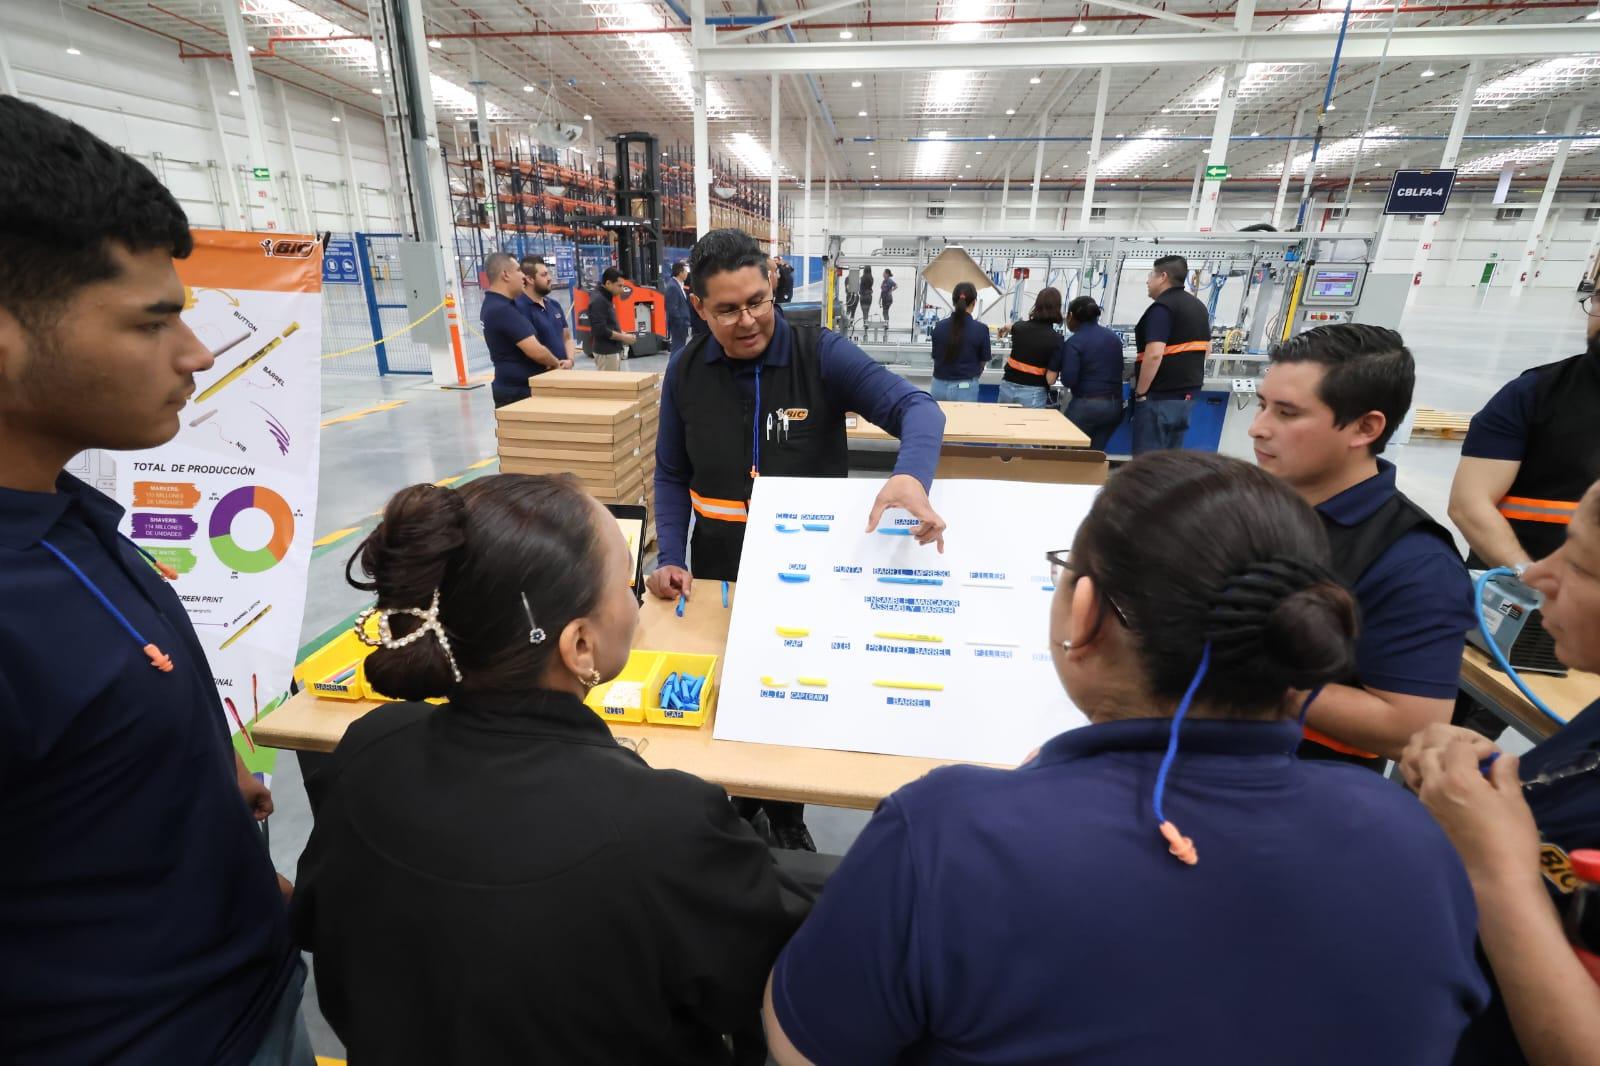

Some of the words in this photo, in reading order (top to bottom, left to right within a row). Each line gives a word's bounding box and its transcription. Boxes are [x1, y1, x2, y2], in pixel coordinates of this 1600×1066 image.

[1397, 188, 1443, 197] CBLFA-4
[233, 310, 258, 332] BUTTON
[262, 366, 285, 387] BARREL
[235, 441, 247, 453] NIB
[133, 462, 167, 472] TOTAL
[171, 463, 185, 473] DE
[187, 464, 256, 476] PRODUCCIÓN
[788, 563, 806, 571] CAP
[833, 565, 862, 573] PUNTA
[872, 567, 906, 575] BARRIL
[911, 569, 951, 577] IMPRESO
[202, 596, 224, 604] PRINT
[864, 596, 910, 605] ENSAMBLE
[913, 598, 961, 607] MARCADOR
[870, 603, 917, 612] ASSEMBLY
[920, 605, 956, 614] MARKER
[784, 639, 803, 648] CAP
[866, 643, 909, 653] PRINTED
[914, 647, 951, 656] BARREL
[760, 689, 786, 699] CLIP
[790, 691, 829, 702] CAP(RAW)
[892, 698, 931, 707] BARREL
